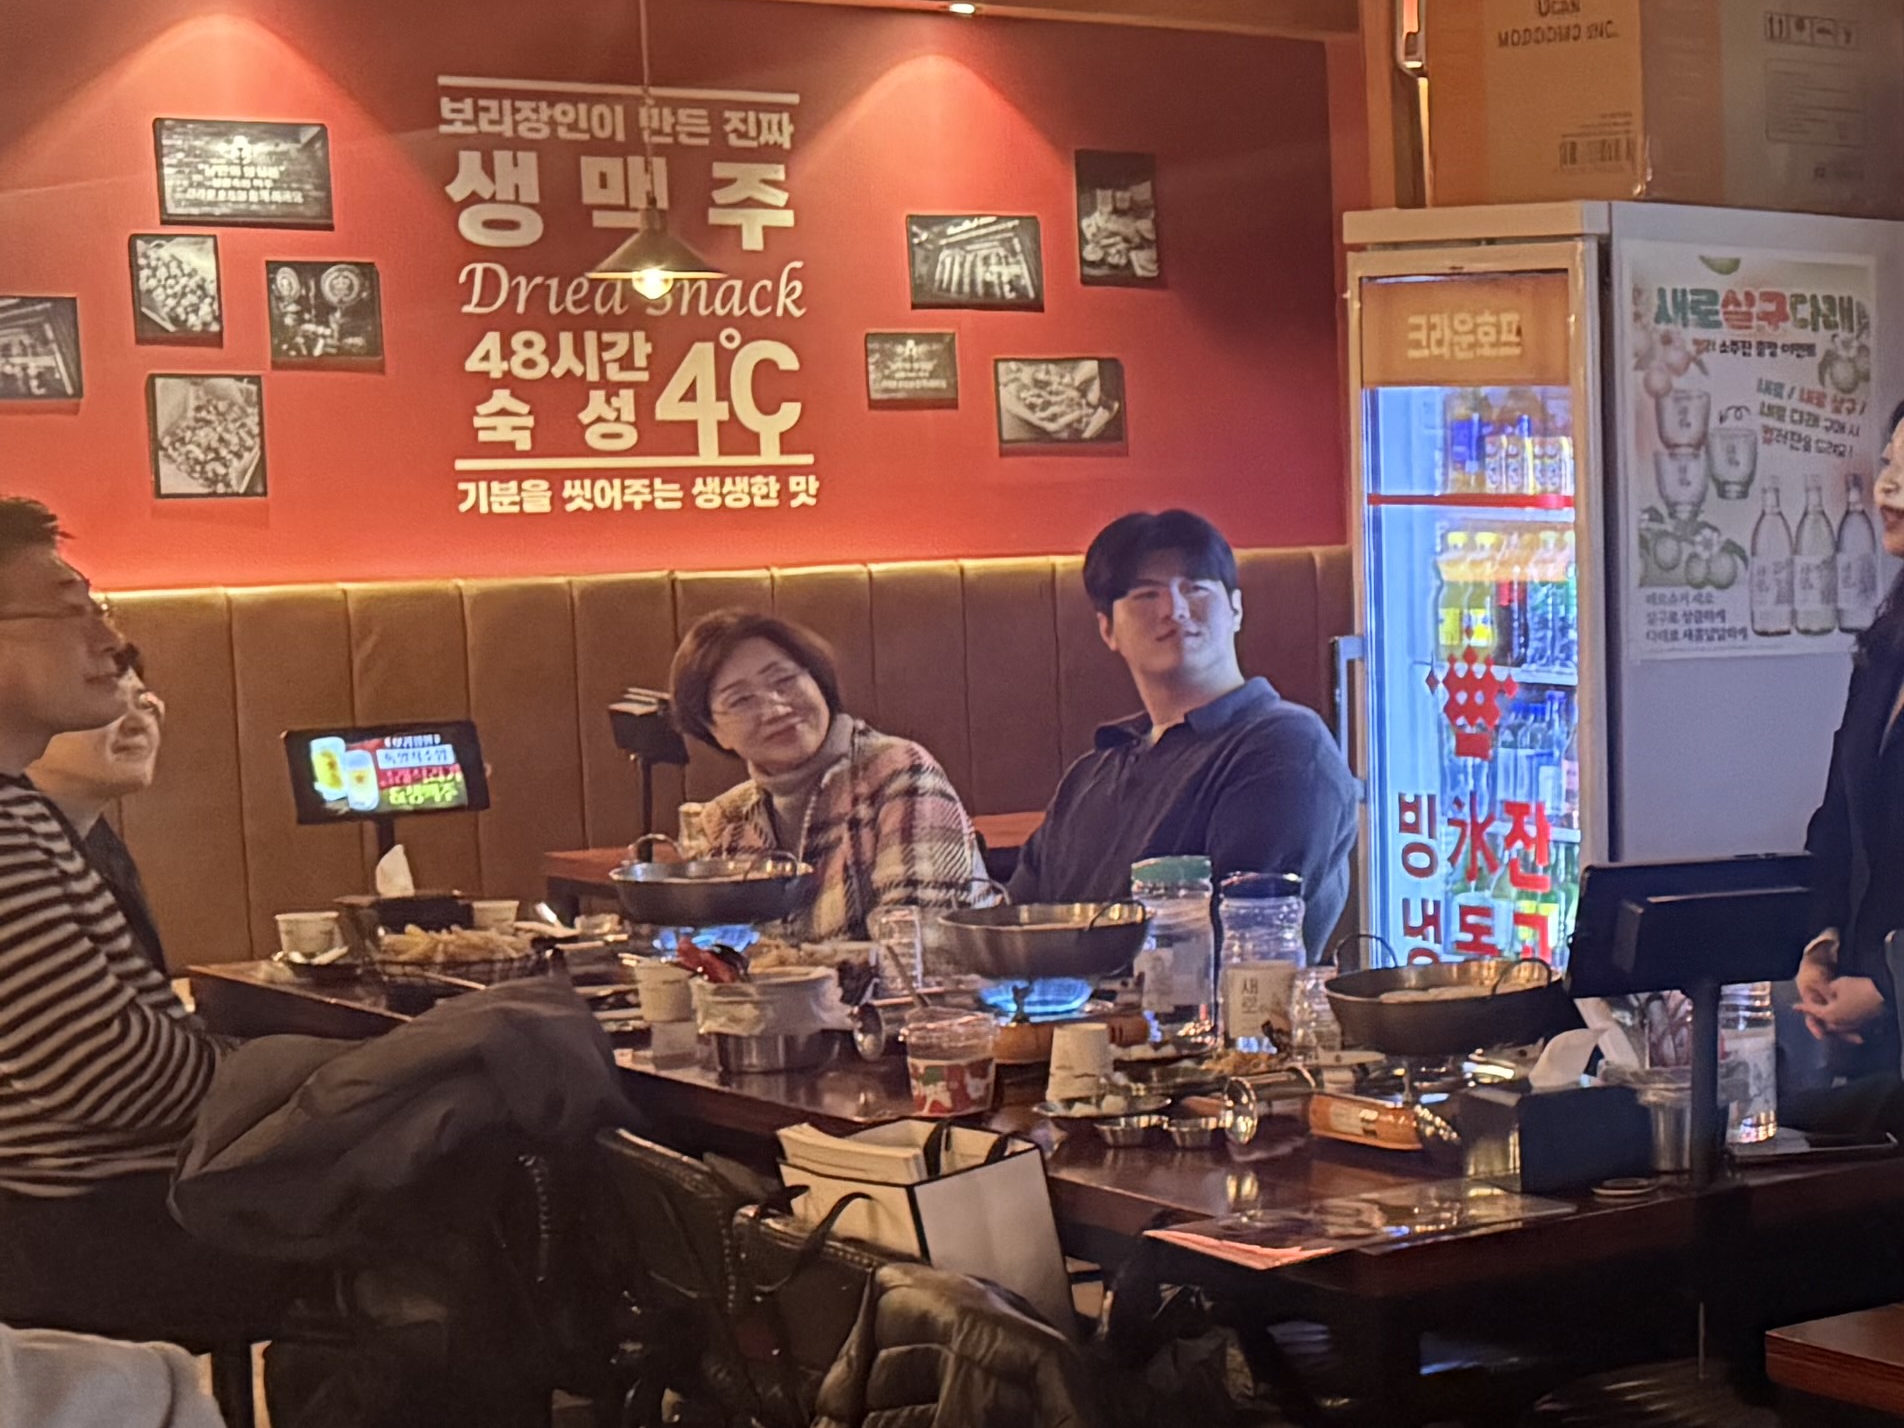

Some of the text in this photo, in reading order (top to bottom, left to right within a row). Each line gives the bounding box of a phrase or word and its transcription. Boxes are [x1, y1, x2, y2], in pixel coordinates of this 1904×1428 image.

[438, 96, 796, 150] 보리장인이 만든 진짜
[464, 329, 652, 383] 48시간
[1407, 310, 1522, 360] 크라운호프
[457, 474, 820, 515] 기분을 씻어주는 생생한 맛
